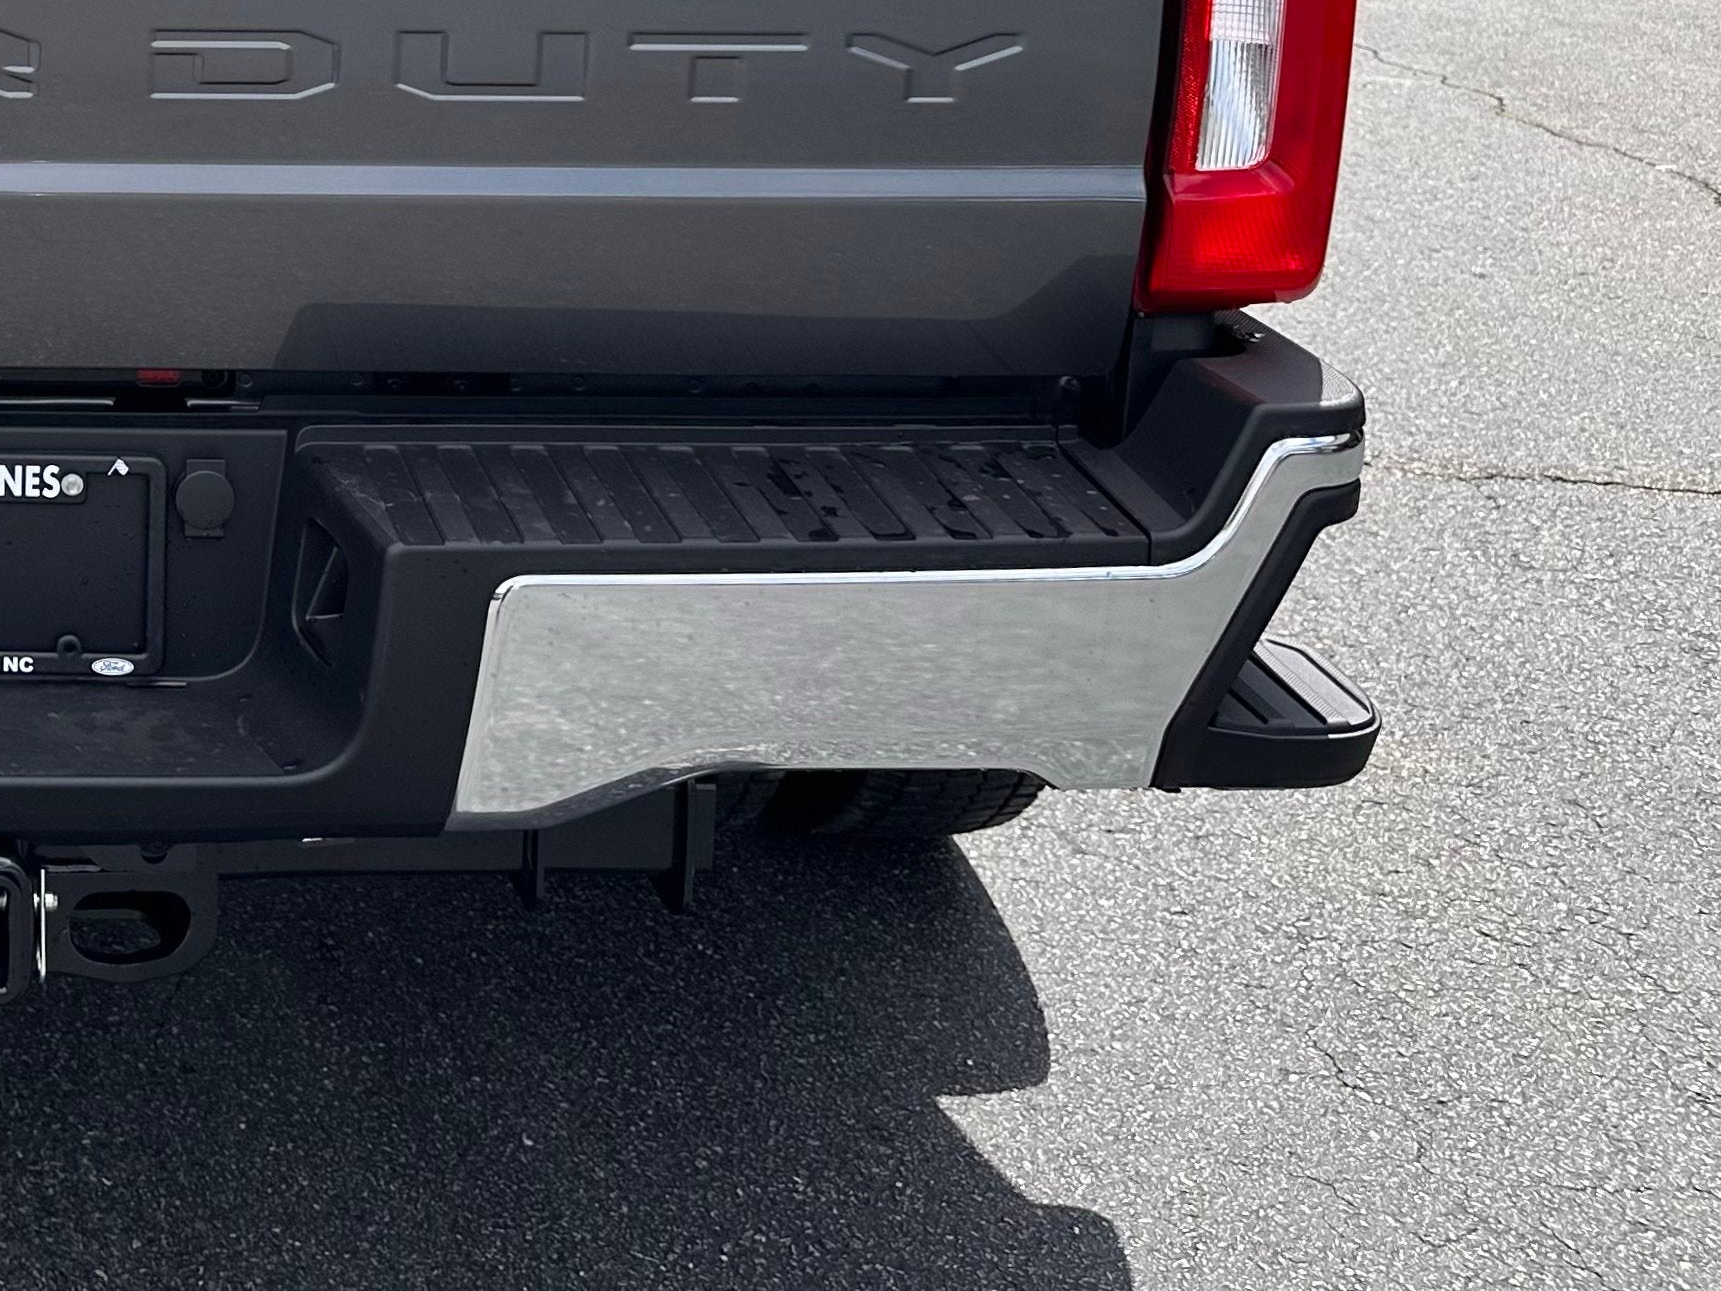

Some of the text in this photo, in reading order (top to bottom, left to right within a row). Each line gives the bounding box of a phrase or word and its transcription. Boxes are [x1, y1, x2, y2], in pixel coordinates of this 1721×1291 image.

[147, 28, 1024, 103] DUTY
[3, 657, 34, 673] NC
[97, 660, 129, 672] Ford
